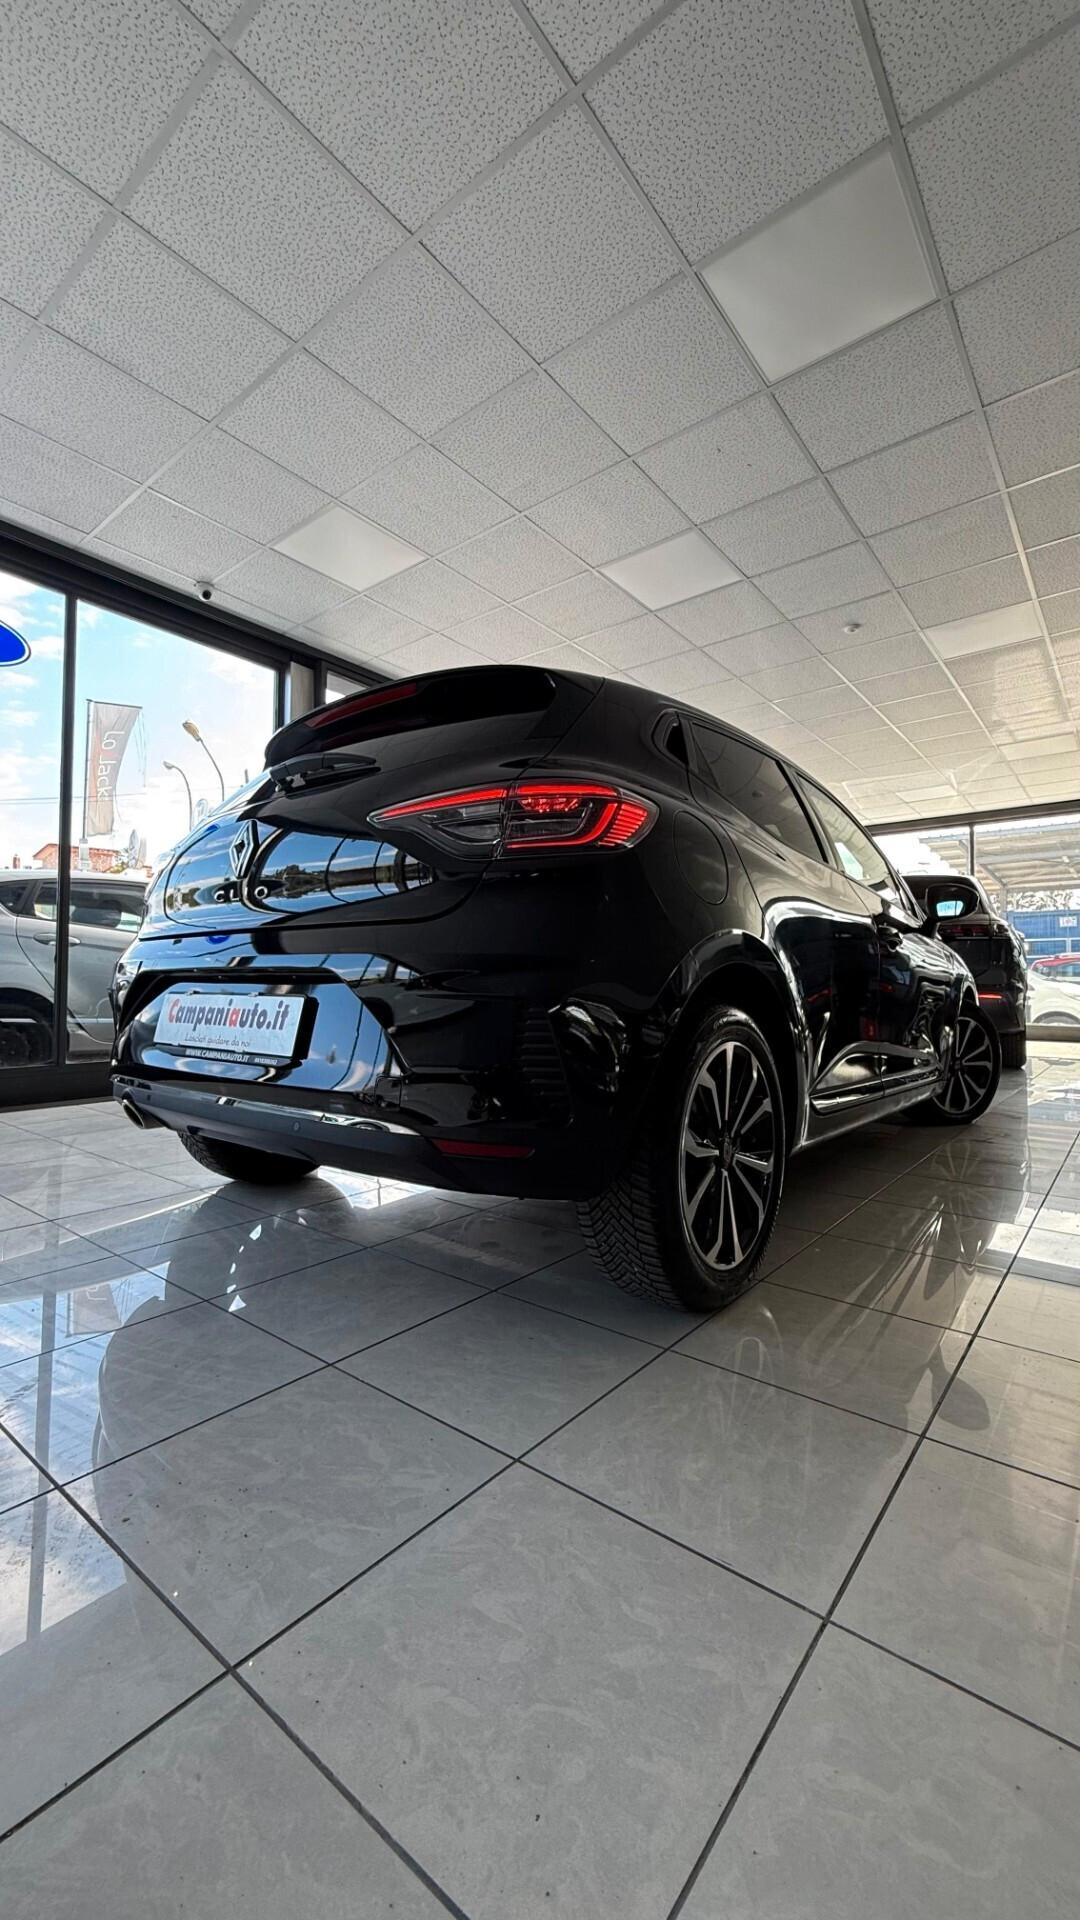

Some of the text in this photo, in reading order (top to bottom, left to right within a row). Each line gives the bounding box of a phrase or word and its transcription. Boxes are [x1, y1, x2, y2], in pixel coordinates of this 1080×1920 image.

[214, 886, 268, 902] CLIO
[169, 999, 291, 1032] Campaniauto.it
[230, 1035, 240, 1047] da
[240, 1039, 251, 1048] noi
